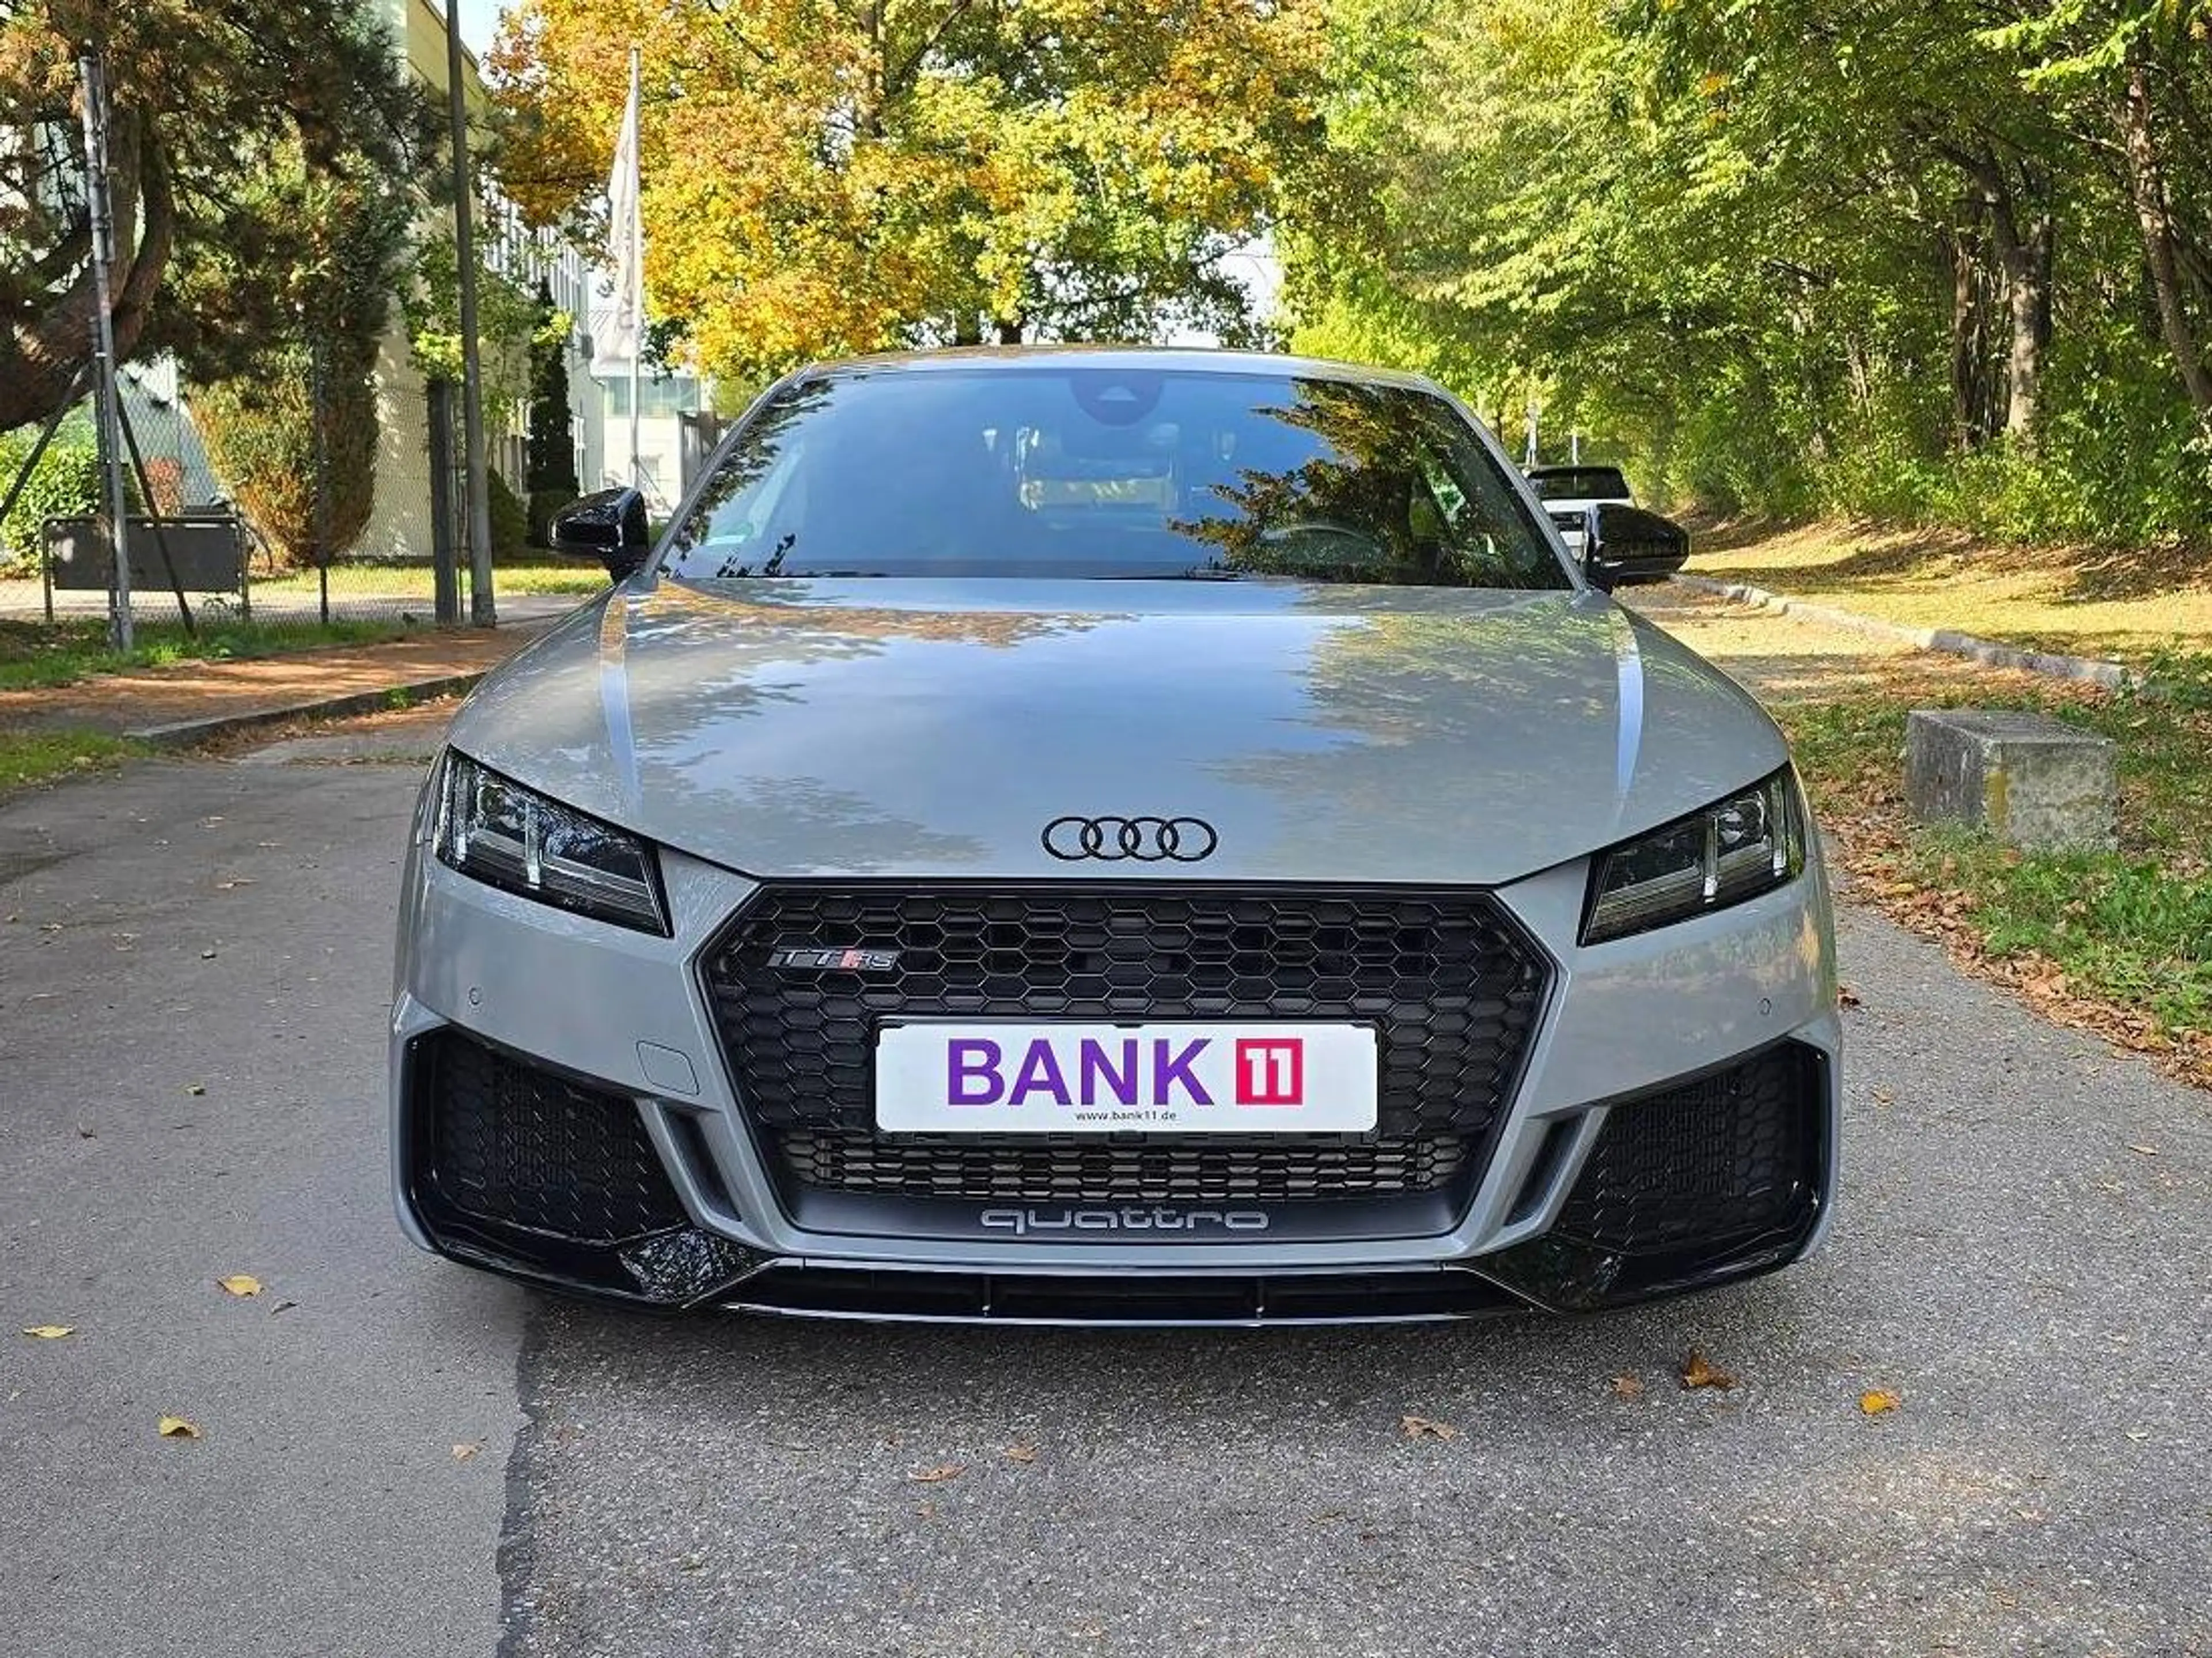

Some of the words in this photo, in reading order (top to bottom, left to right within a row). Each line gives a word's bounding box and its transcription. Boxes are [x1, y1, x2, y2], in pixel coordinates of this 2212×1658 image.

[948, 1038, 1214, 1105] BANK
[1245, 1048, 1293, 1097] 11
[1075, 1110, 1177, 1121] www.bank11.de
[981, 1206, 1269, 1234] quattro
